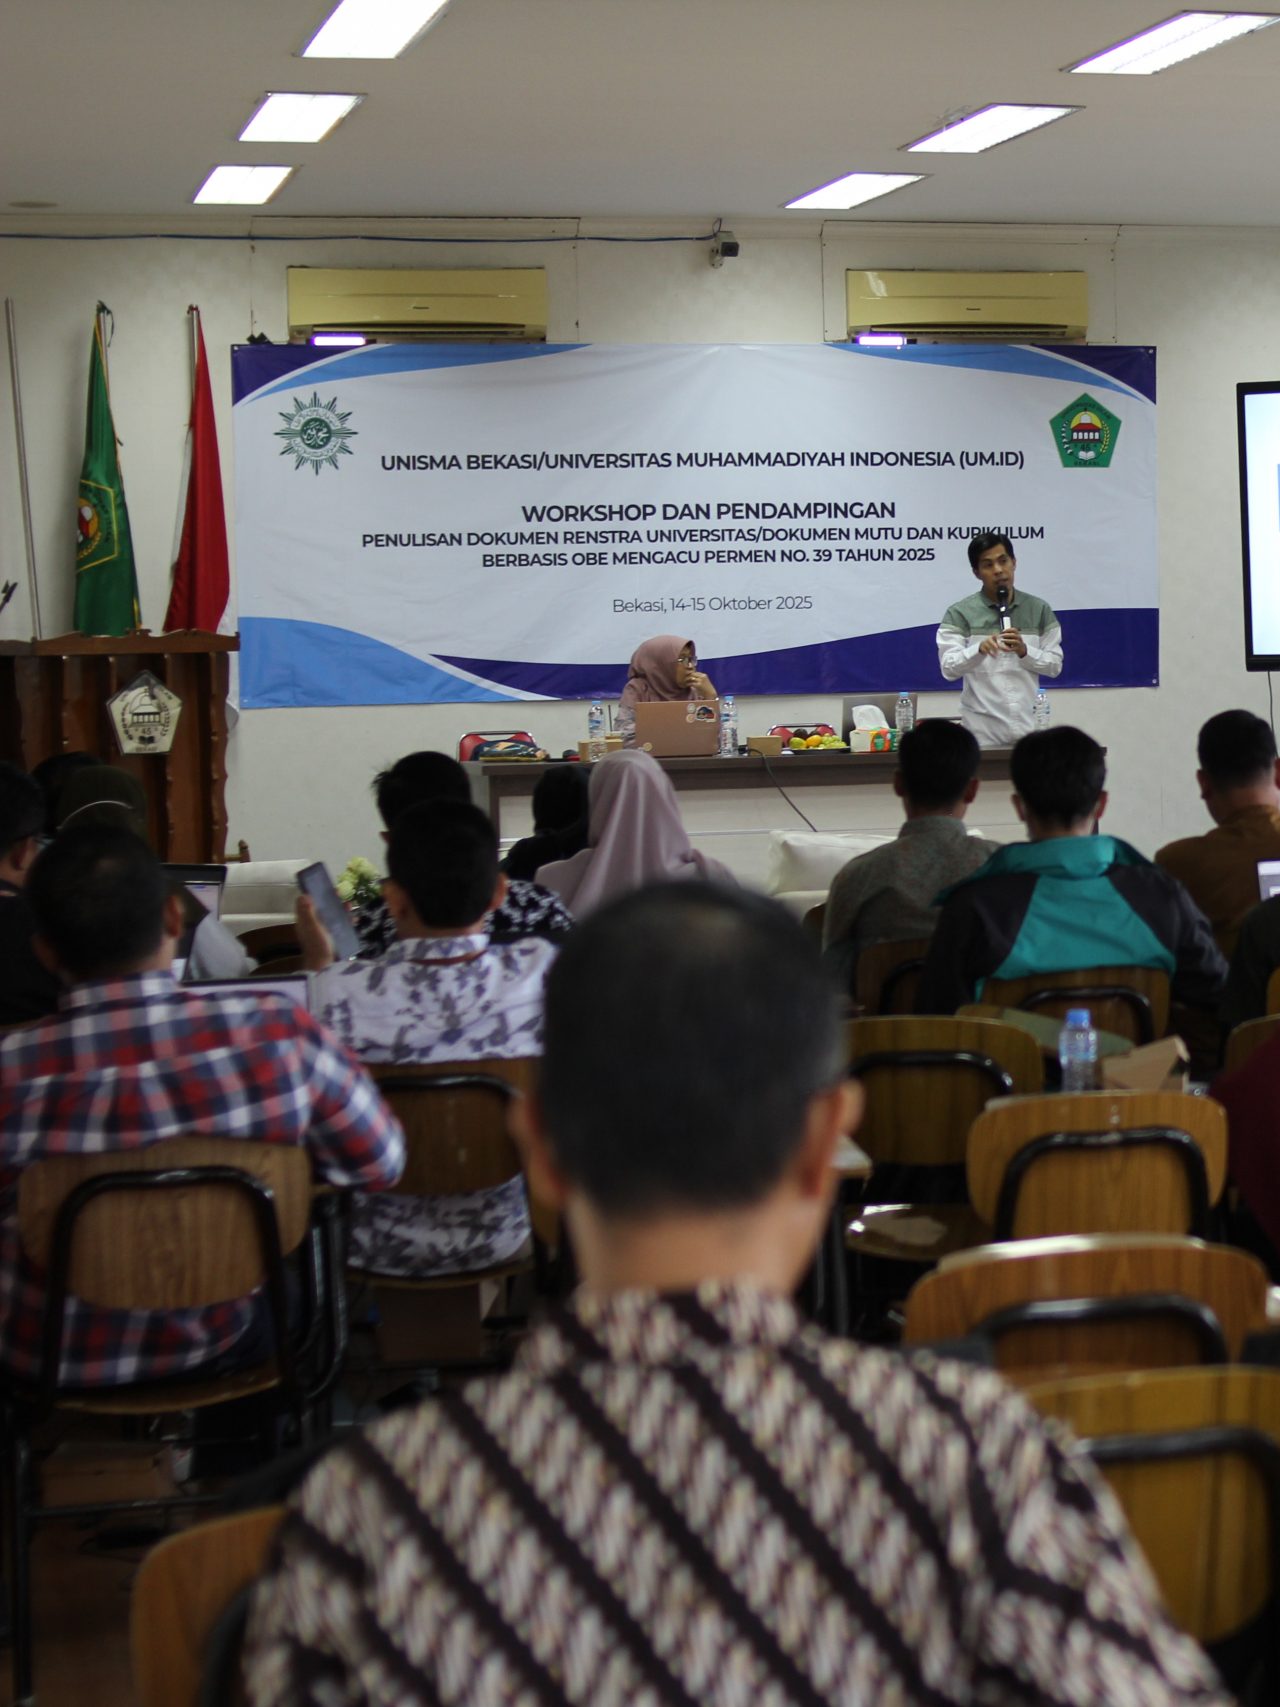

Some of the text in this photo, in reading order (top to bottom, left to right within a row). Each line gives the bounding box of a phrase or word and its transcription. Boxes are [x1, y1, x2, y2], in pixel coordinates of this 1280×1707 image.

[381, 450, 1025, 472] UNISMA BEKASI/UNIVERSITAS MUHAMMADIYAH INDONESIA (UM.ID)
[521, 501, 896, 523] WORKSHOP DAN PENDAMPINGAN
[362, 532, 463, 548] PENULISAN
[466, 531, 559, 546] DOKUMEN
[563, 530, 643, 545] RENSTRA
[646, 525, 851, 544] UNIVERSITAS/DOKUMEN
[854, 527, 903, 541] MUTU
[906, 526, 944, 541] DAN
[482, 547, 936, 568] BERBASIS OBE MENGACU PERMEN NO. 39 TAHUN 2025
[612, 595, 813, 614] Bekasi, 14-15 Oktober 2025
